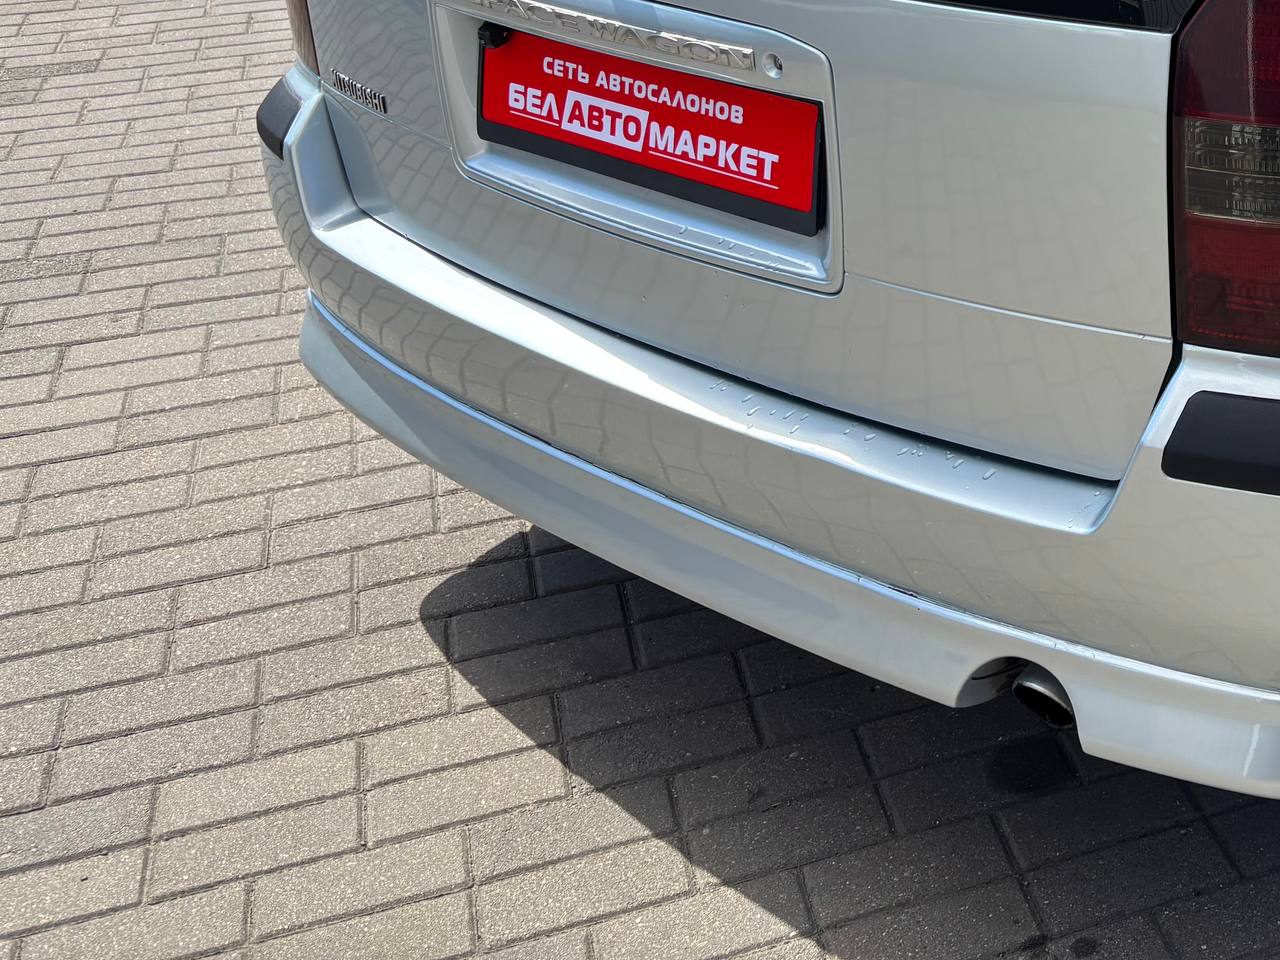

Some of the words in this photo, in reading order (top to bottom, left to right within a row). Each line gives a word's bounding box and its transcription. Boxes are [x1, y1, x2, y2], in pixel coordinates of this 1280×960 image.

[587, 16, 756, 71] WAGON
[542, 56, 590, 86] СЕТЬ
[595, 71, 744, 125] АВТОСАЛОНОВ
